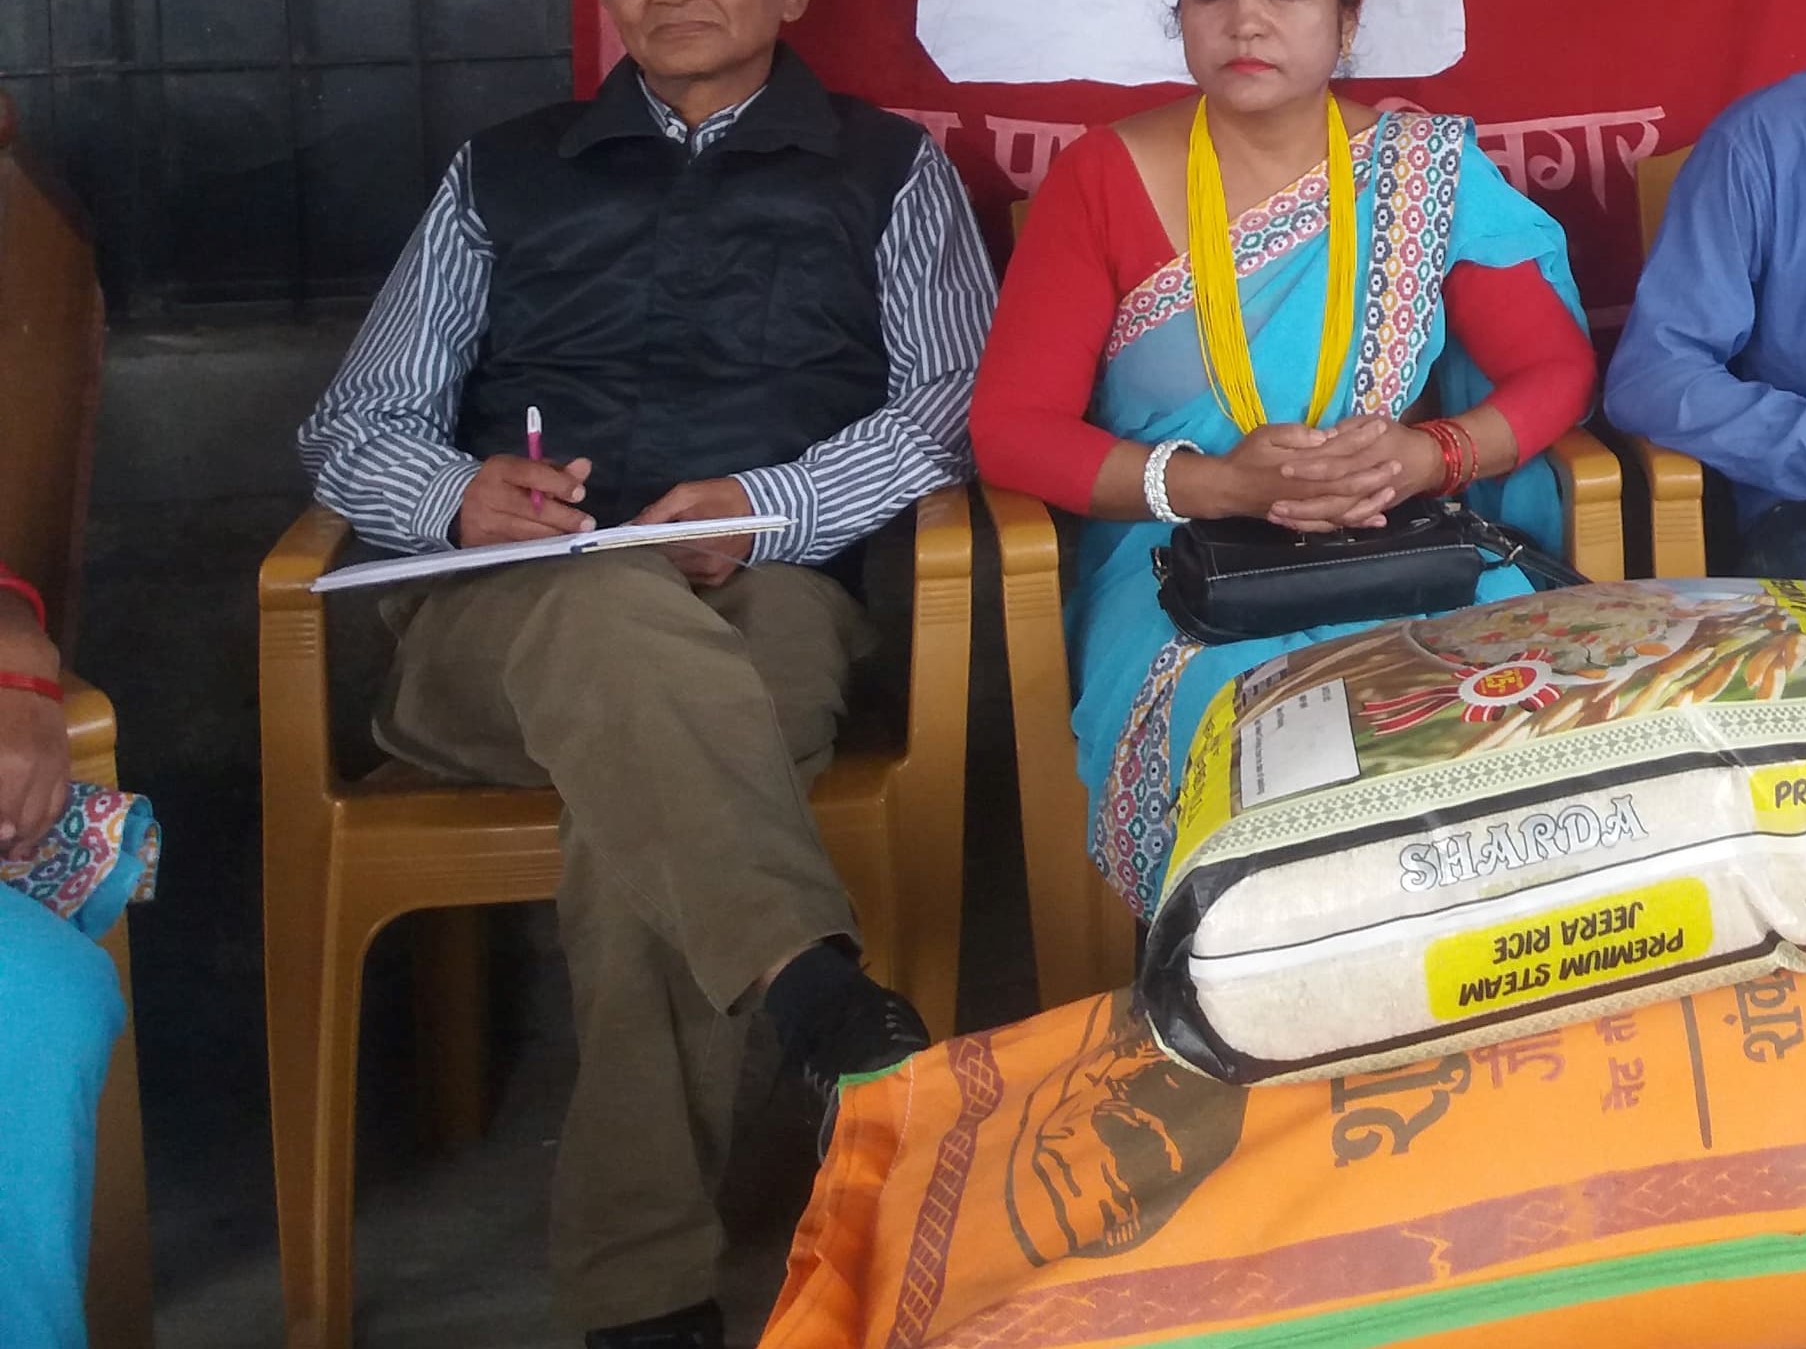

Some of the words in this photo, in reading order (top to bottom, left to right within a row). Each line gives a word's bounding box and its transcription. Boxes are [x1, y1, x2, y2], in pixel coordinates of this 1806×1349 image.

[1399, 794, 1650, 894] SHARDA
[1493, 926, 1551, 966] RICE
[1560, 901, 1645, 947] JEERA
[1559, 927, 1684, 982] PREMIUM
[1459, 963, 1552, 1007] STEAM
